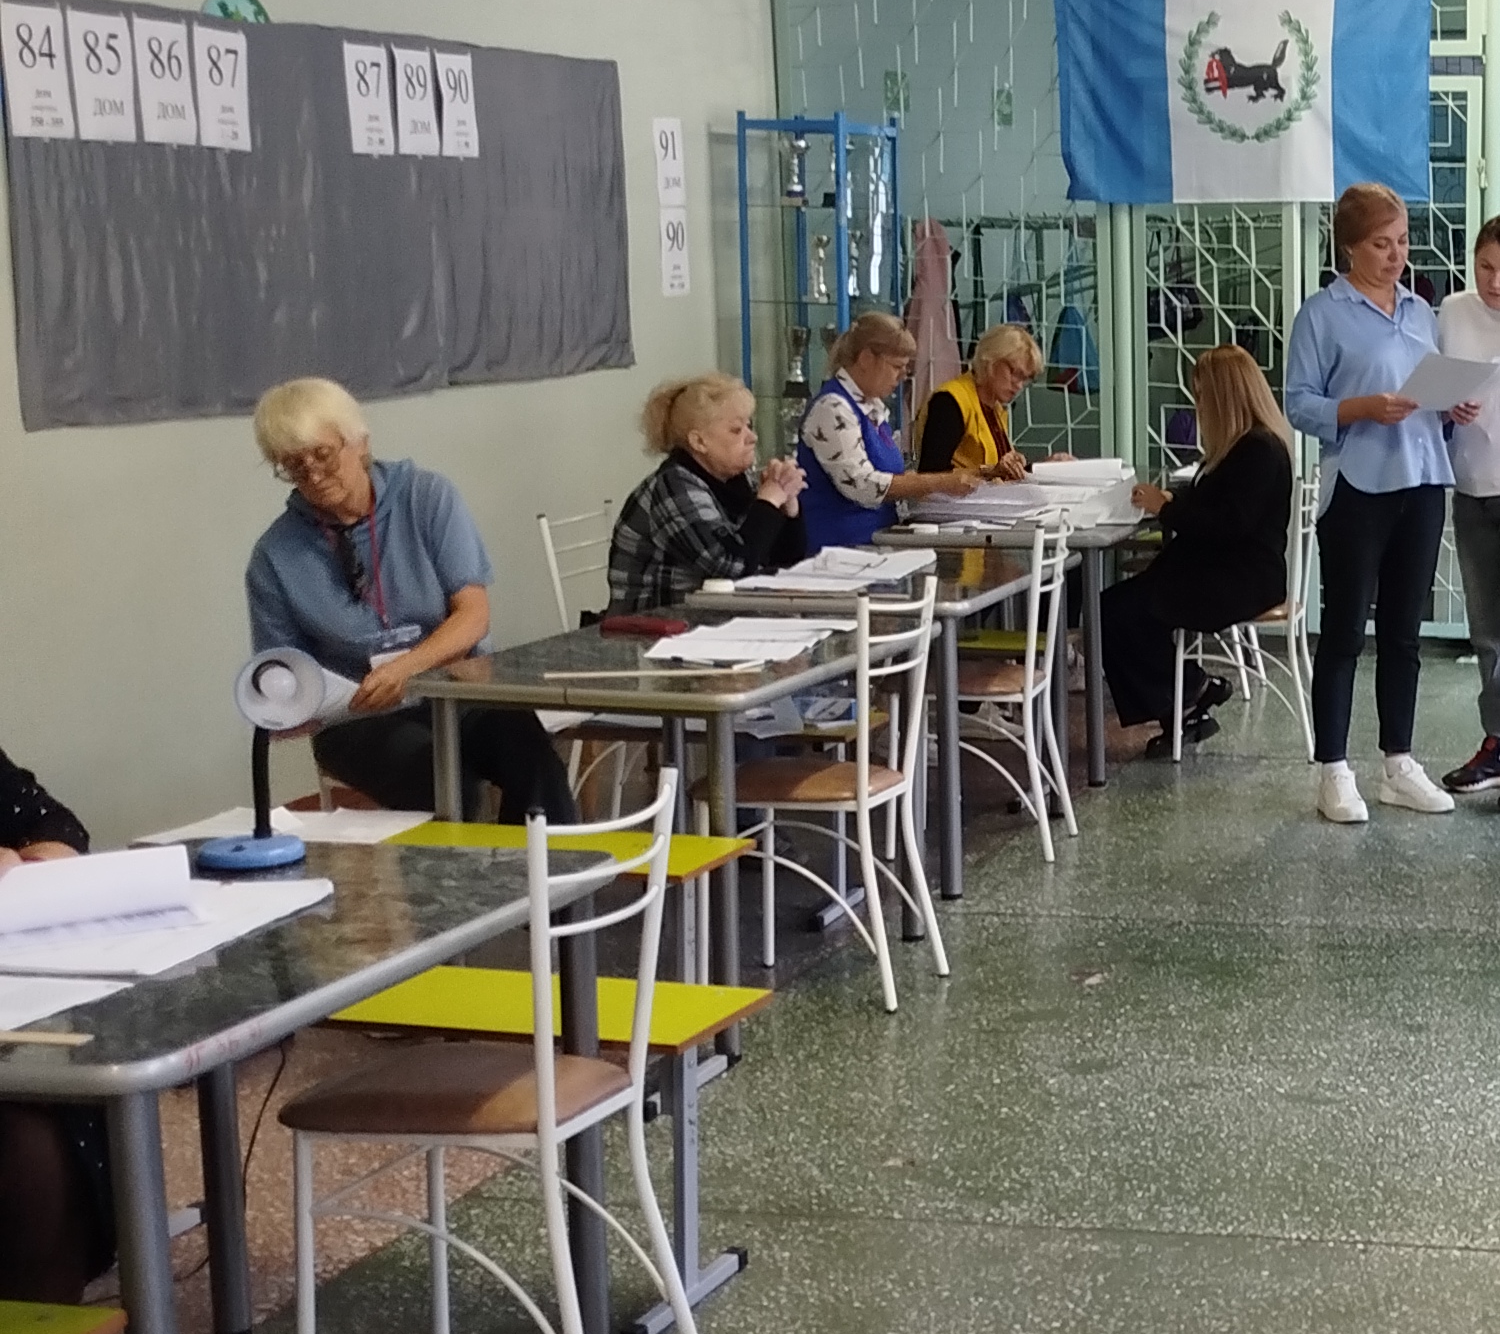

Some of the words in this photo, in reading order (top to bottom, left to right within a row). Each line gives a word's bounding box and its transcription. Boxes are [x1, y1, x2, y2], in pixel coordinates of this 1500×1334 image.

[16, 23, 57, 69] 84
[82, 30, 122, 76] 85
[147, 36, 182, 82] 86
[206, 45, 239, 88] 87
[354, 59, 381, 99] 87
[404, 63, 428, 101] 89
[446, 67, 469, 104] 90
[93, 97, 125, 117] ДОМ
[156, 101, 186, 120] ДОМ
[659, 129, 677, 161] 91
[666, 220, 685, 252] 90
